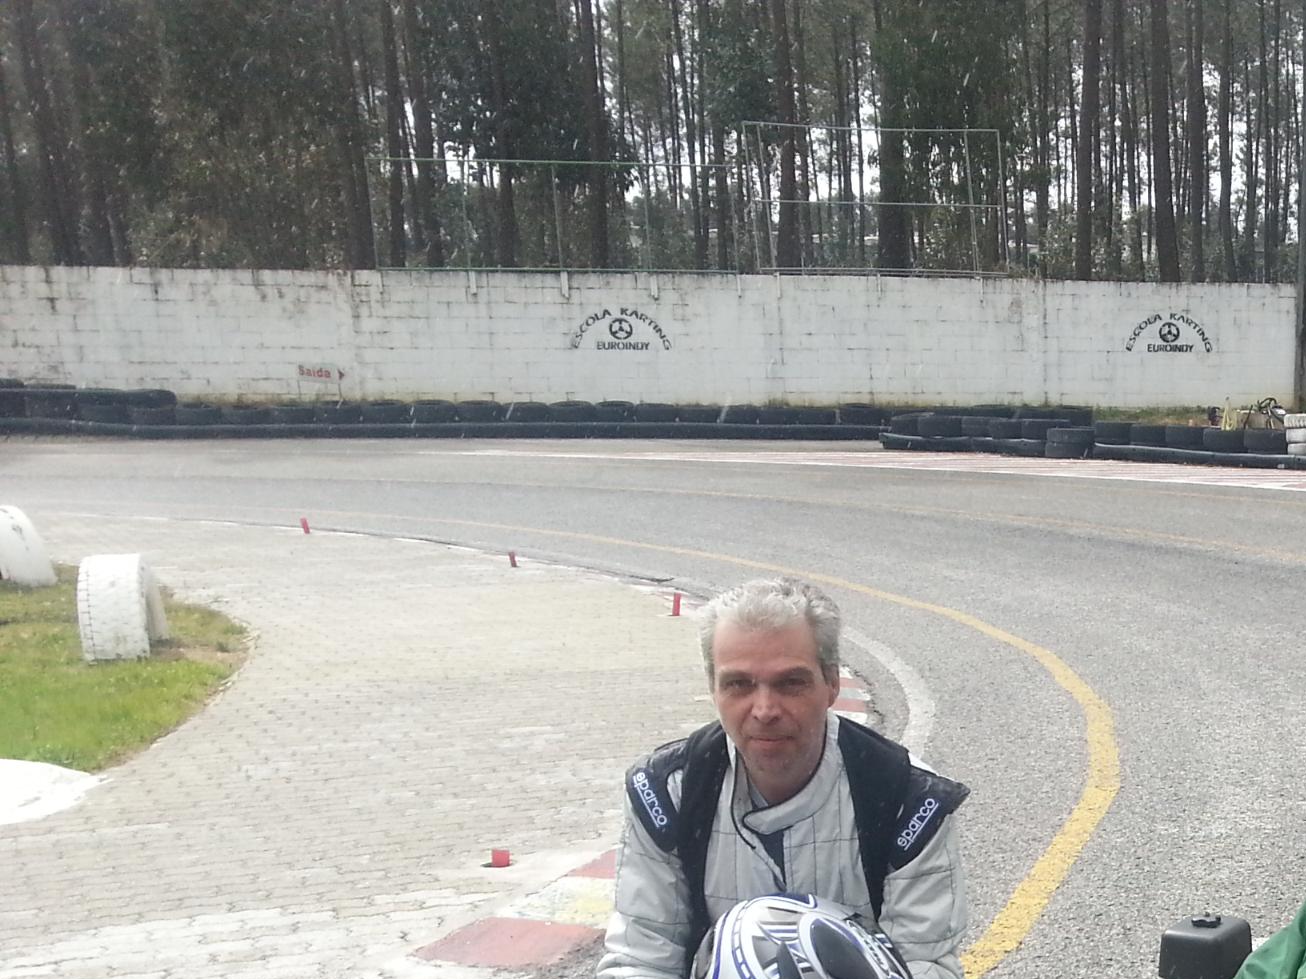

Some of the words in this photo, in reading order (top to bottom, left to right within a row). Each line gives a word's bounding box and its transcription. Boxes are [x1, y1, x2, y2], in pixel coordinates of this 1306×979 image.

[571, 308, 612, 349] ESCOLA
[620, 307, 672, 351] KARTING
[596, 341, 650, 351] EUROINDY
[1125, 313, 1162, 352] ESCOLA
[1169, 312, 1213, 353] KARTING
[1147, 343, 1194, 353] EUROINDY
[632, 771, 668, 828] sparco
[896, 798, 939, 850] sparco
